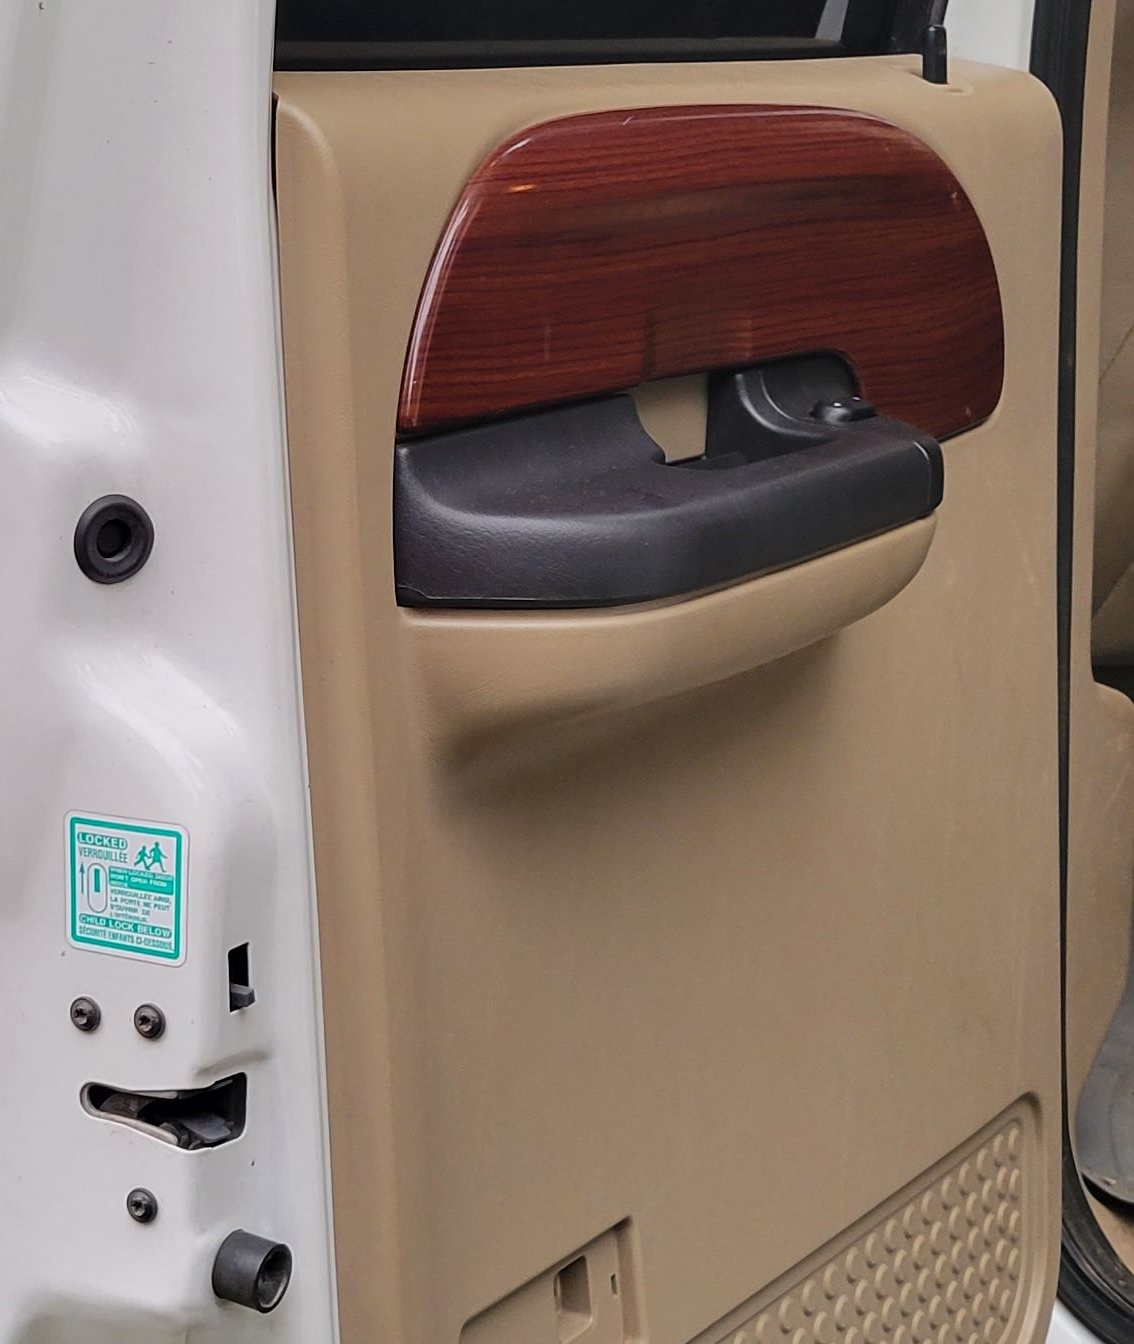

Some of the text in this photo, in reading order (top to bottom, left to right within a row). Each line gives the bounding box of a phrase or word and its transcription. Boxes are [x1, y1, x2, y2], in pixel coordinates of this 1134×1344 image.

[79, 832, 126, 850] LOCKED
[80, 915, 171, 937] CHILD LOCK BELOW
